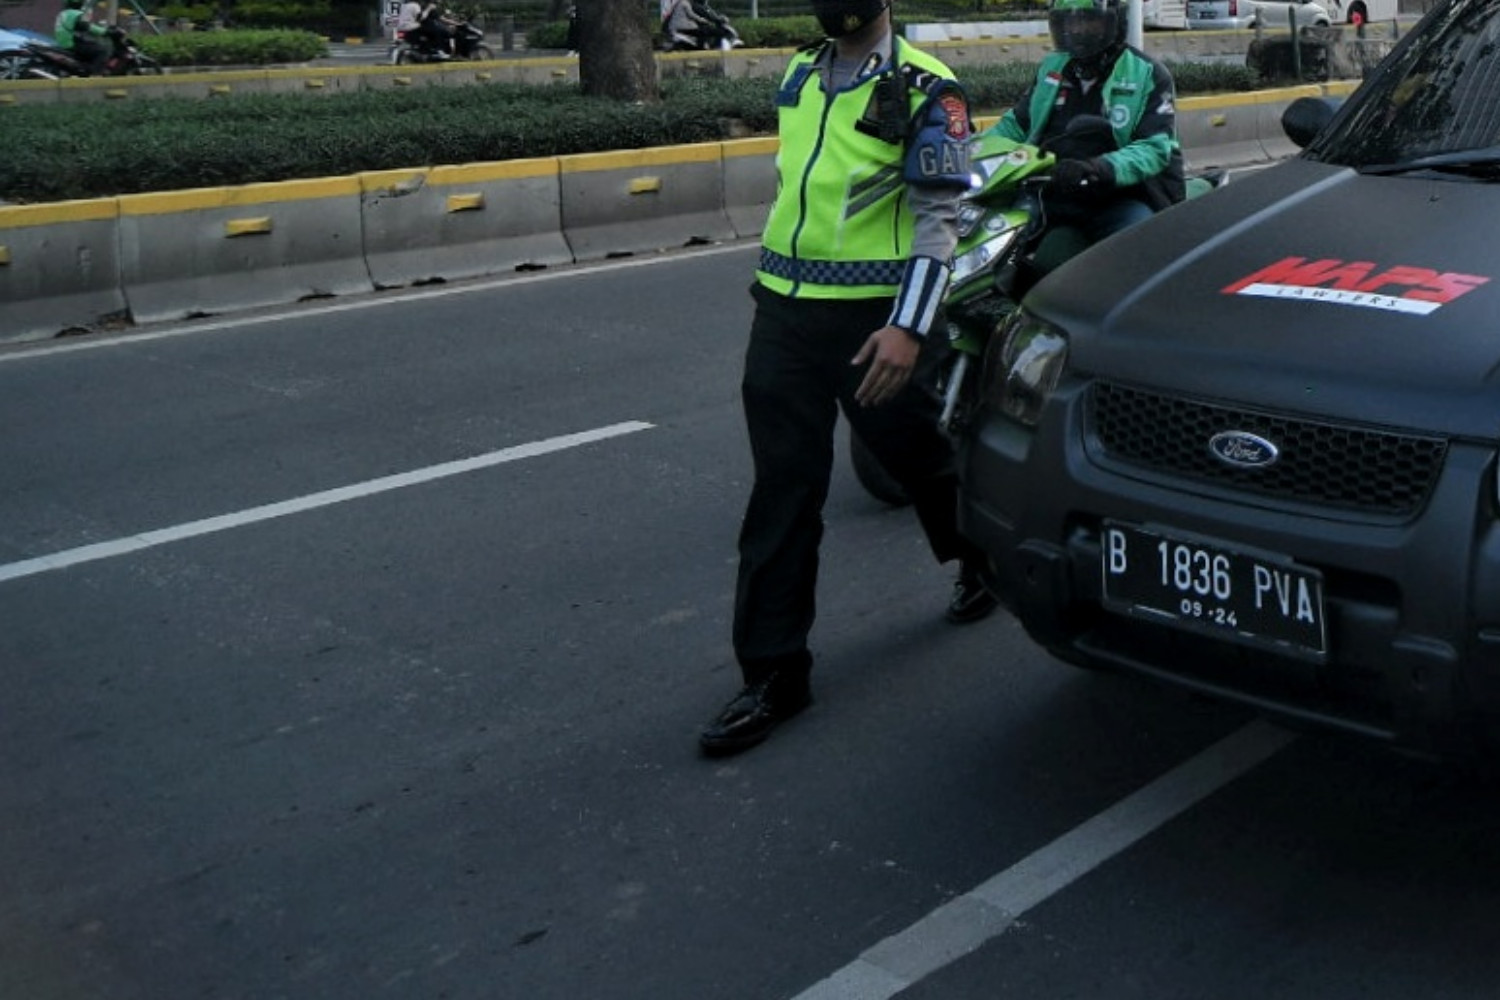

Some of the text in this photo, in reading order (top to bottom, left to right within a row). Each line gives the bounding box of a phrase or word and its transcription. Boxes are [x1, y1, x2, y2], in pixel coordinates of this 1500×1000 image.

[1220, 256, 1491, 304] MAPS
[1223, 438, 1262, 461] Ford
[1109, 530, 1314, 624] B 1836 PVA
